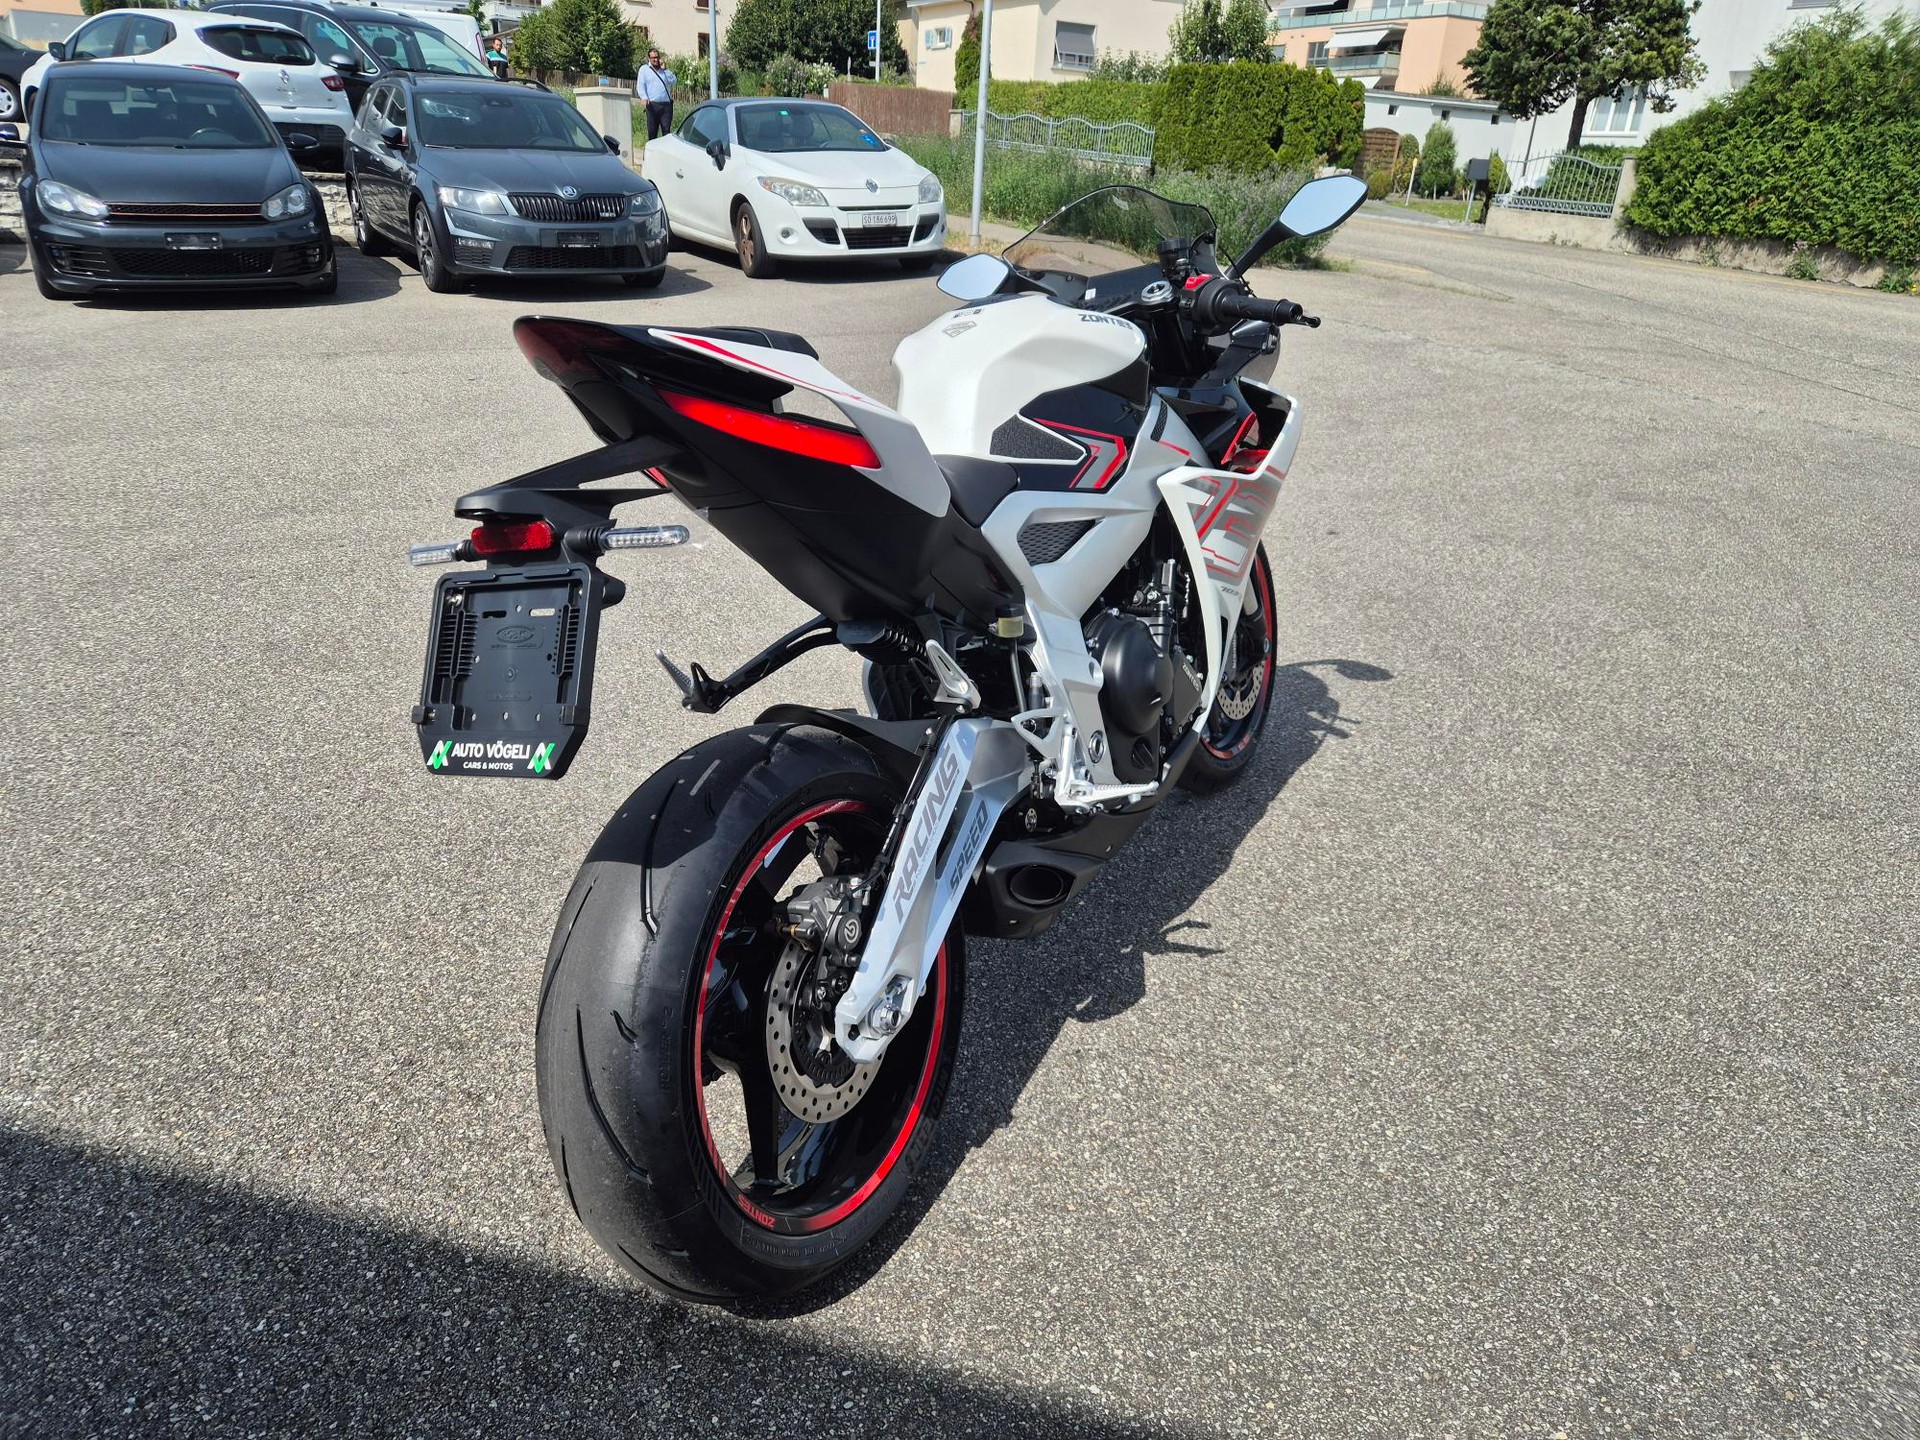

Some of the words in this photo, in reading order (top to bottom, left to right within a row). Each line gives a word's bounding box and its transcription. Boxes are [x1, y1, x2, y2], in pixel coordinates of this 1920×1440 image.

[450, 742, 485, 759] AUTO
[486, 739, 531, 760] VÖGELI
[462, 761, 482, 770] CARS
[482, 761, 488, 770] &
[488, 762, 514, 771] MOTOS
[893, 745, 959, 924] RACING
[950, 799, 989, 893] SPEED
[738, 1193, 776, 1229] ZONTES
